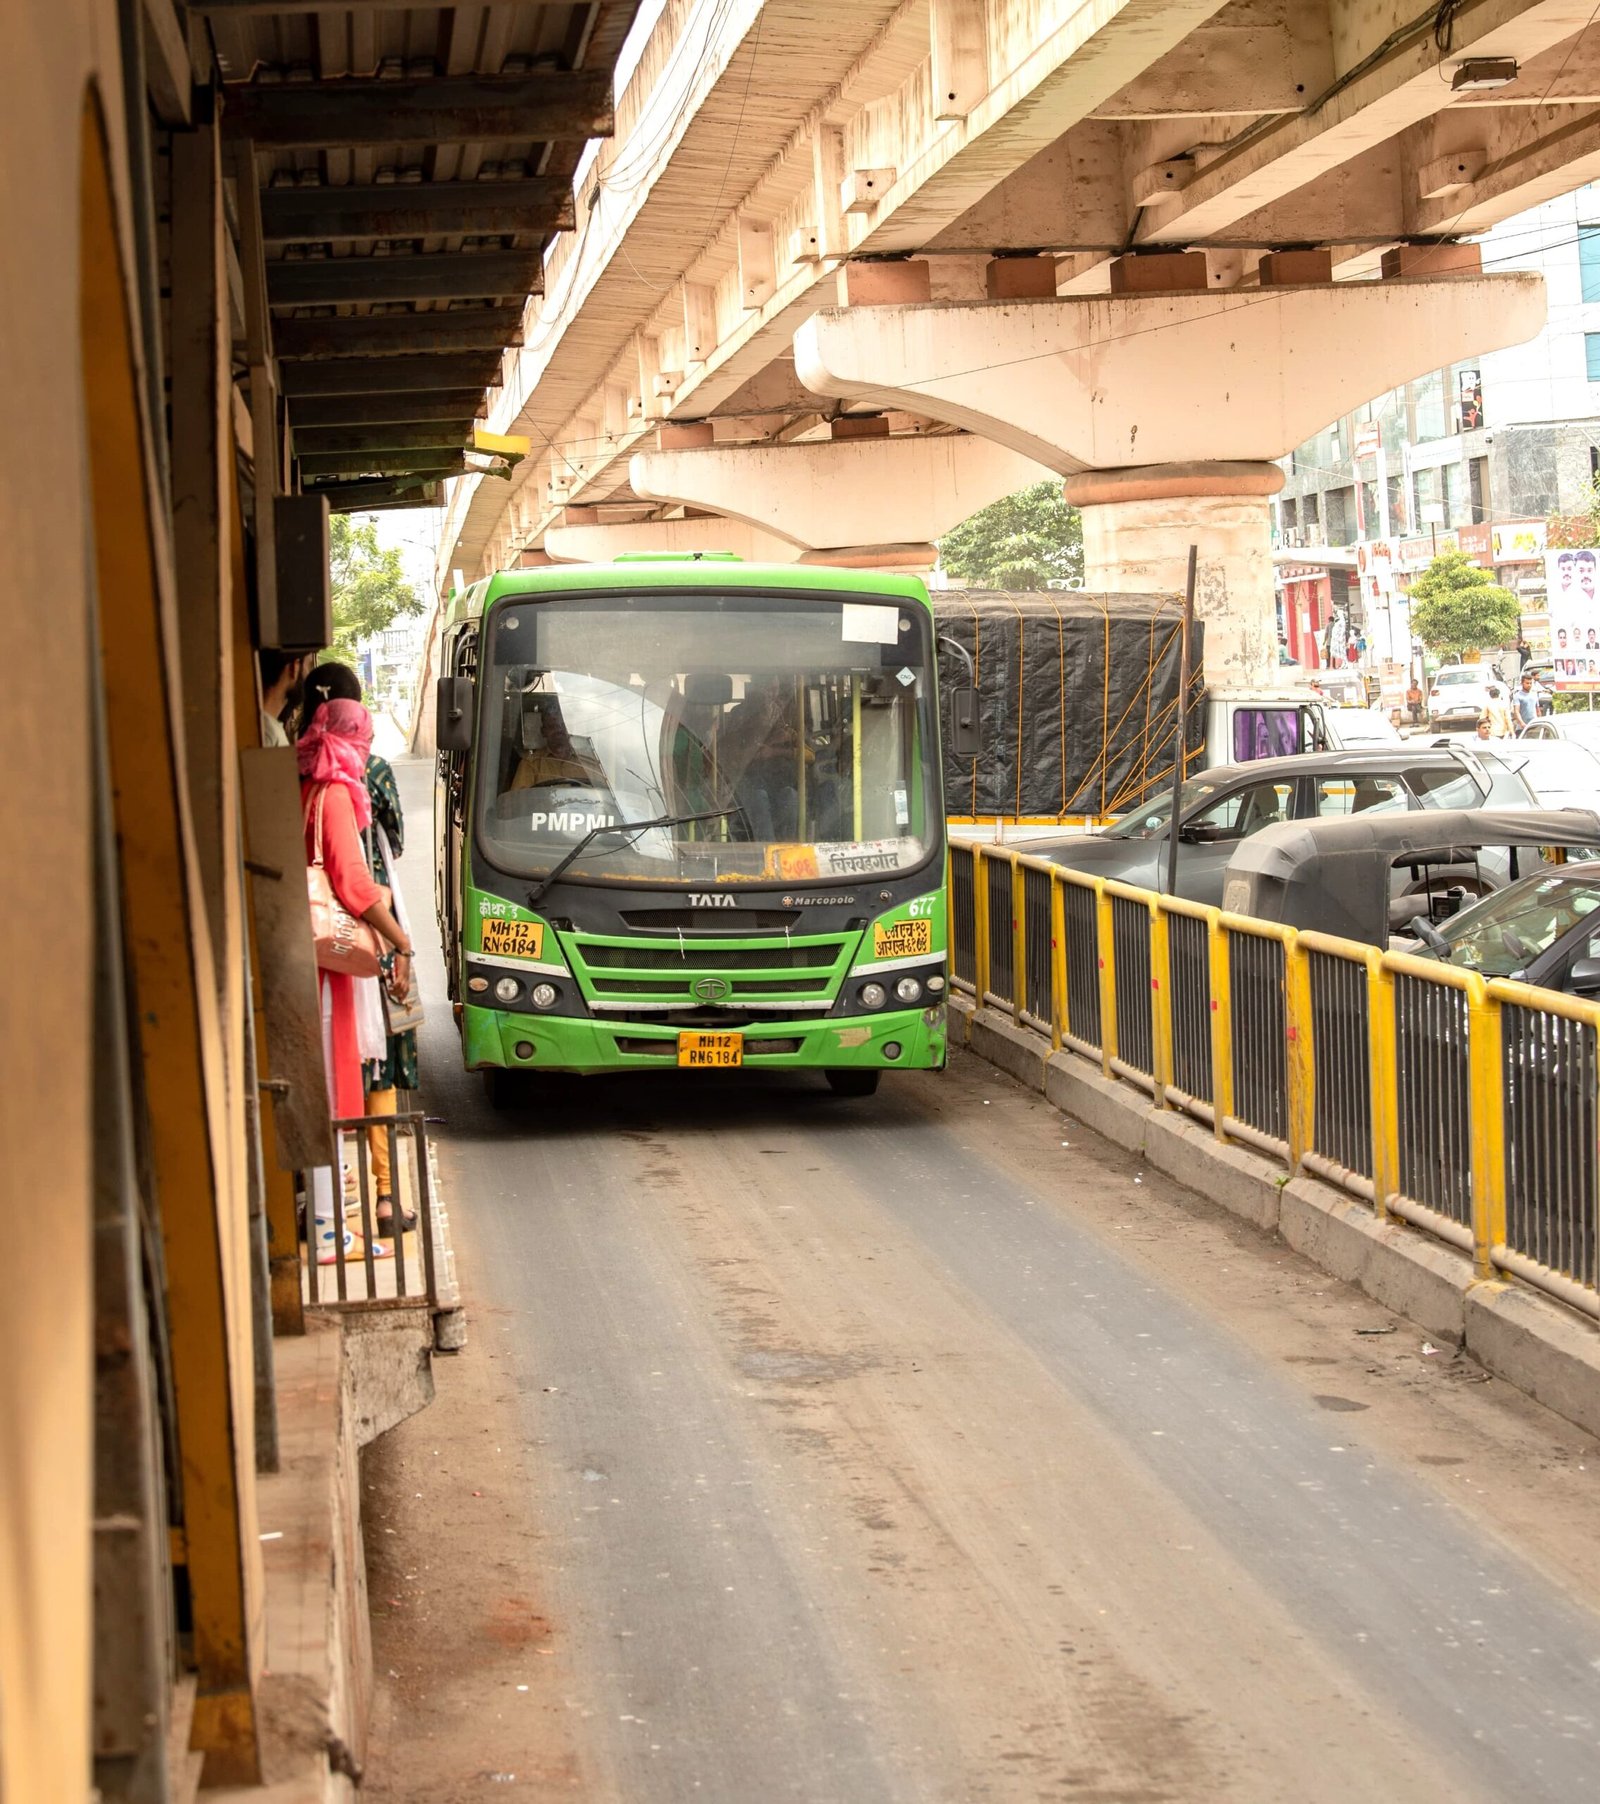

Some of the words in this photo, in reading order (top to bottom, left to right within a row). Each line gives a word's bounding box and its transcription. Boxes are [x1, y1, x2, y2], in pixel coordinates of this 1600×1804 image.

[688, 894, 736, 907] TATA
[794, 896, 855, 906] Marcopolo
[909, 897, 936, 917] 677
